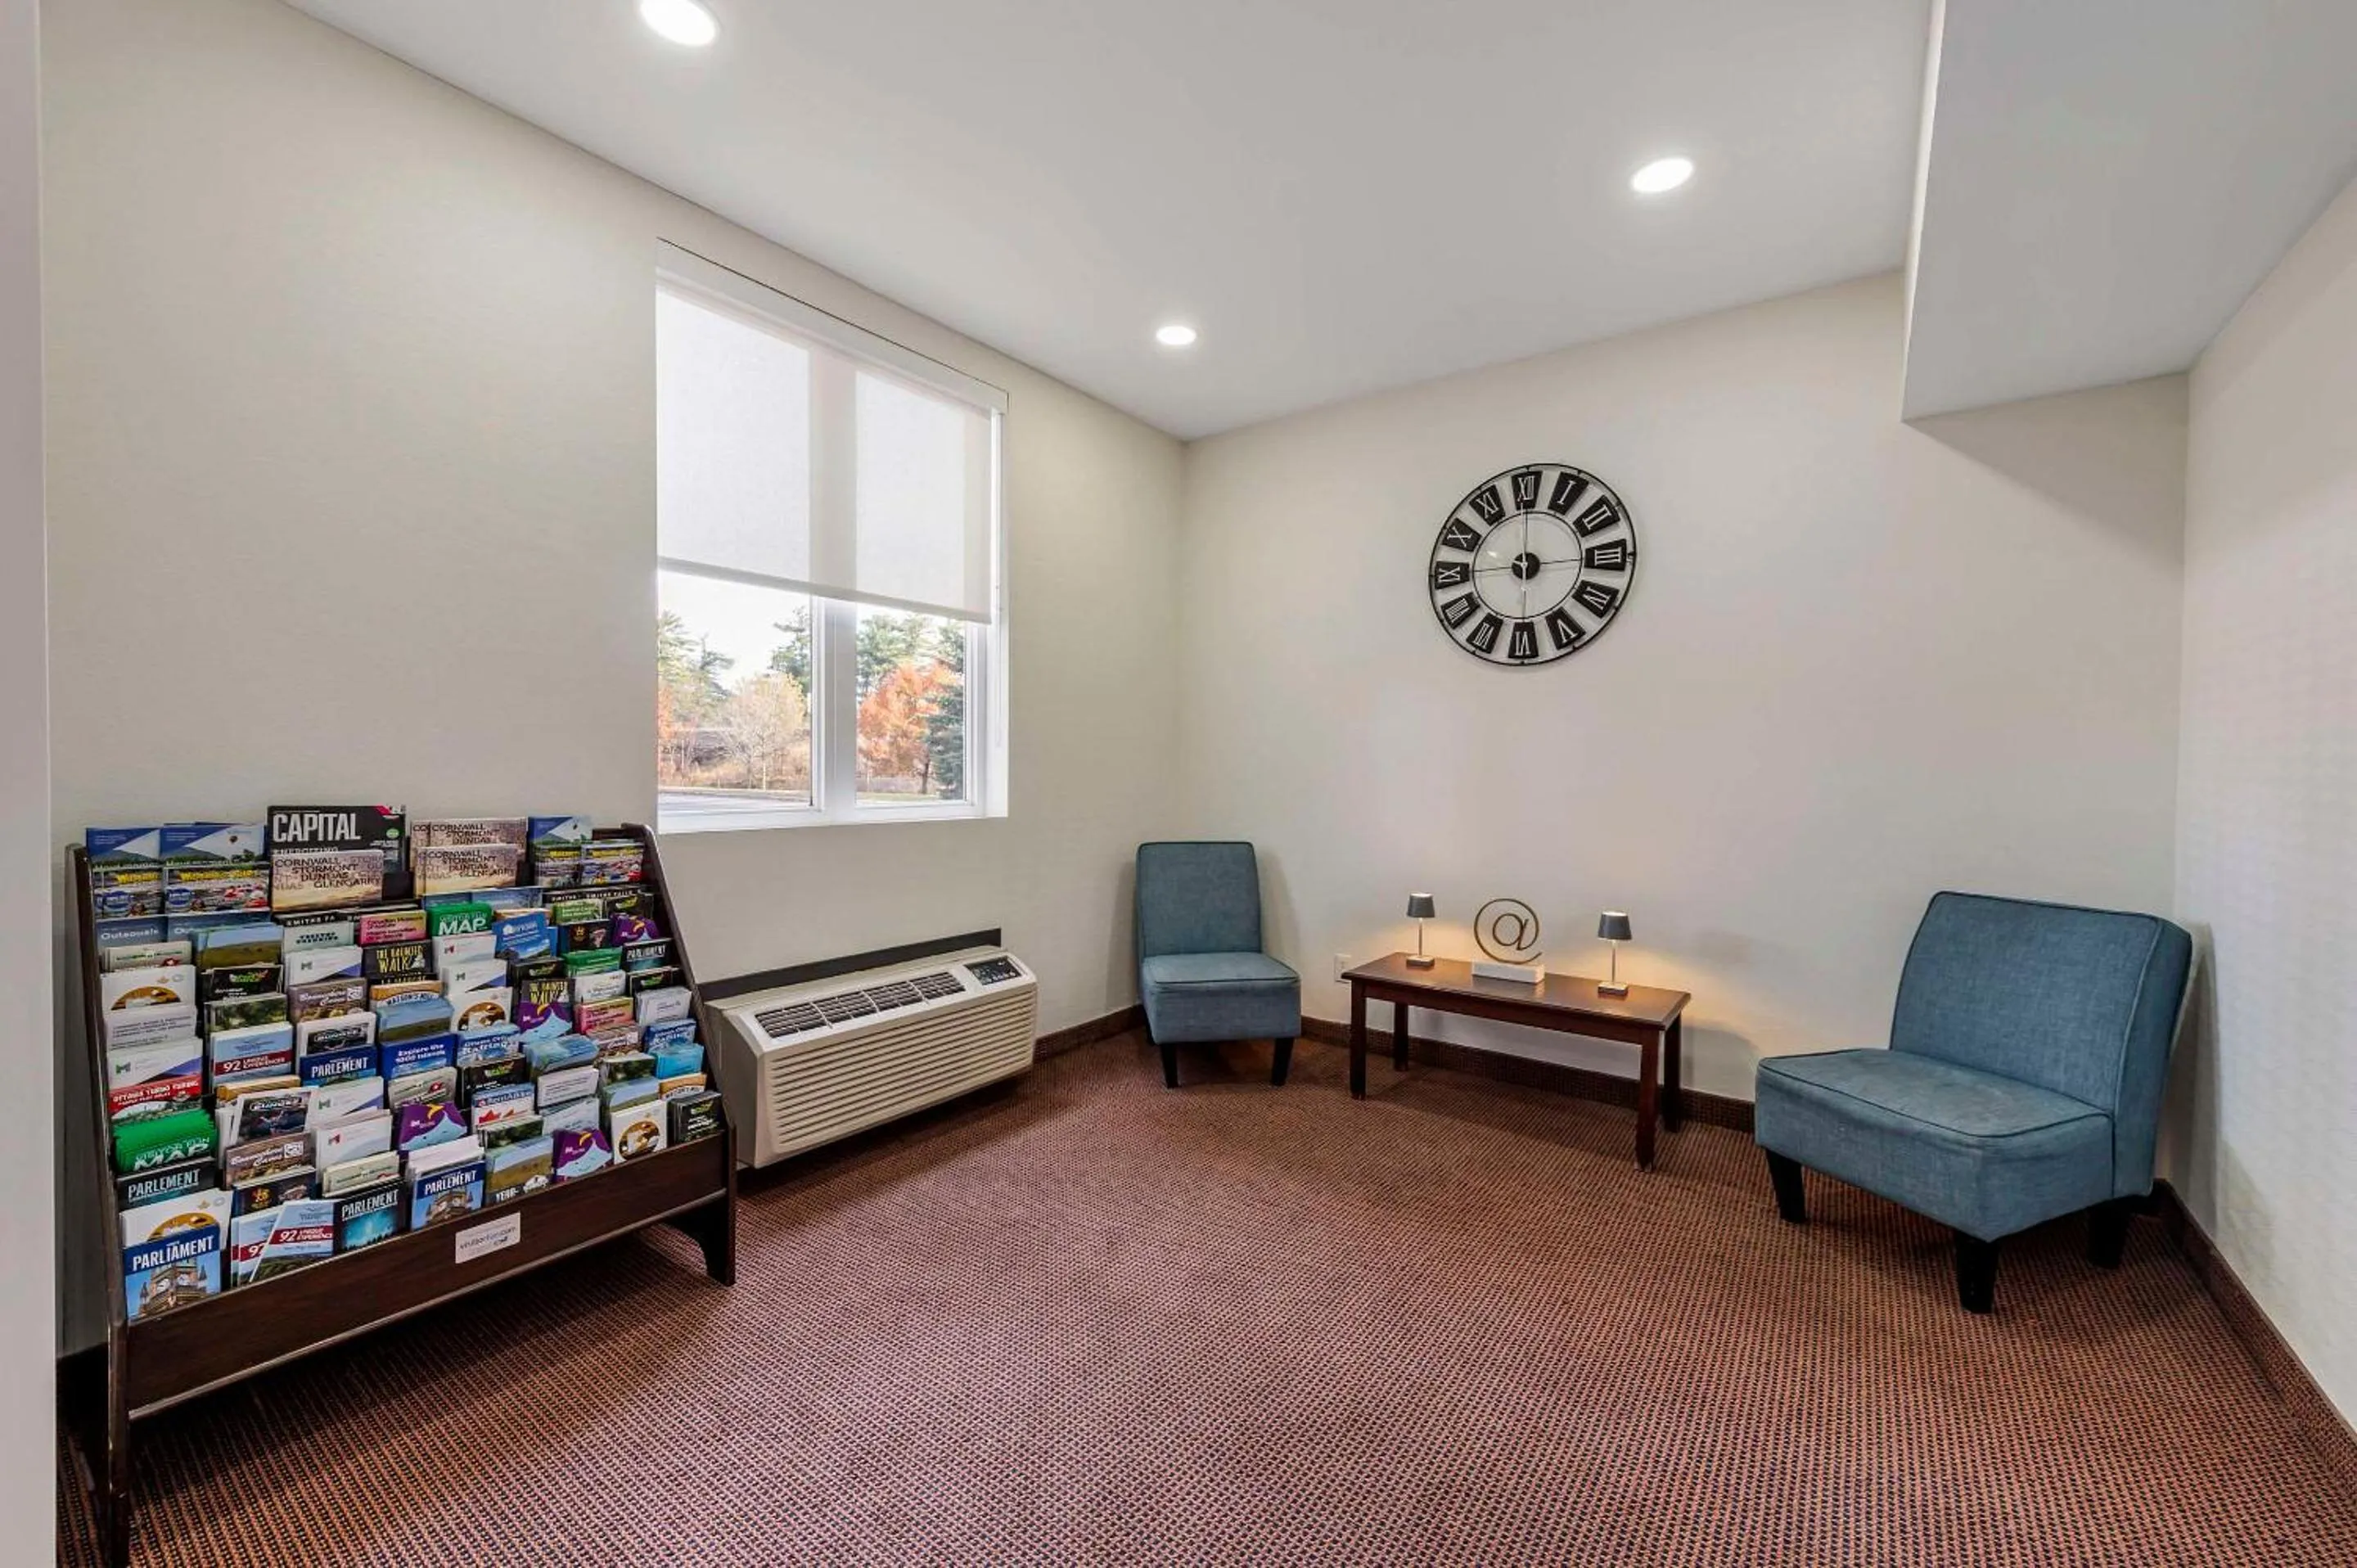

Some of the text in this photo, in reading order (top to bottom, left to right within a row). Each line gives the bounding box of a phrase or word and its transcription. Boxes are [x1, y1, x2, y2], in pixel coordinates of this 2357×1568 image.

[1518, 475, 1536, 501] XII
[1582, 504, 1611, 530] II
[1446, 526, 1472, 547] X
[1594, 547, 1622, 565] III
[1438, 566, 1461, 583] IX
[1557, 619, 1578, 643] V
[1515, 631, 1531, 656] VI
[273, 813, 361, 843] CAPITAL
[432, 822, 486, 832] CORNWALL
[274, 857, 341, 868] CORNWALL
[427, 849, 483, 859] CORNWALL
[291, 863, 359, 874] STORMONT
[300, 872, 349, 882] DUNDAS
[313, 877, 382, 889] GLENGARRY
[438, 917, 488, 936] MAP
[378, 956, 410, 974] WALK
[398, 1046, 430, 1057] Explore
[223, 1061, 242, 1073] 92
[311, 1057, 368, 1079] PARLEMENT
[133, 1143, 210, 1171] MAP
[128, 1168, 201, 1199] PARLEMENT
[424, 1169, 477, 1195] PARLEMENT
[341, 1188, 399, 1219] PARLEMENT
[278, 1230, 333, 1242] 92 EXPERIENCE
[132, 1235, 214, 1271] PARLIAMENT
